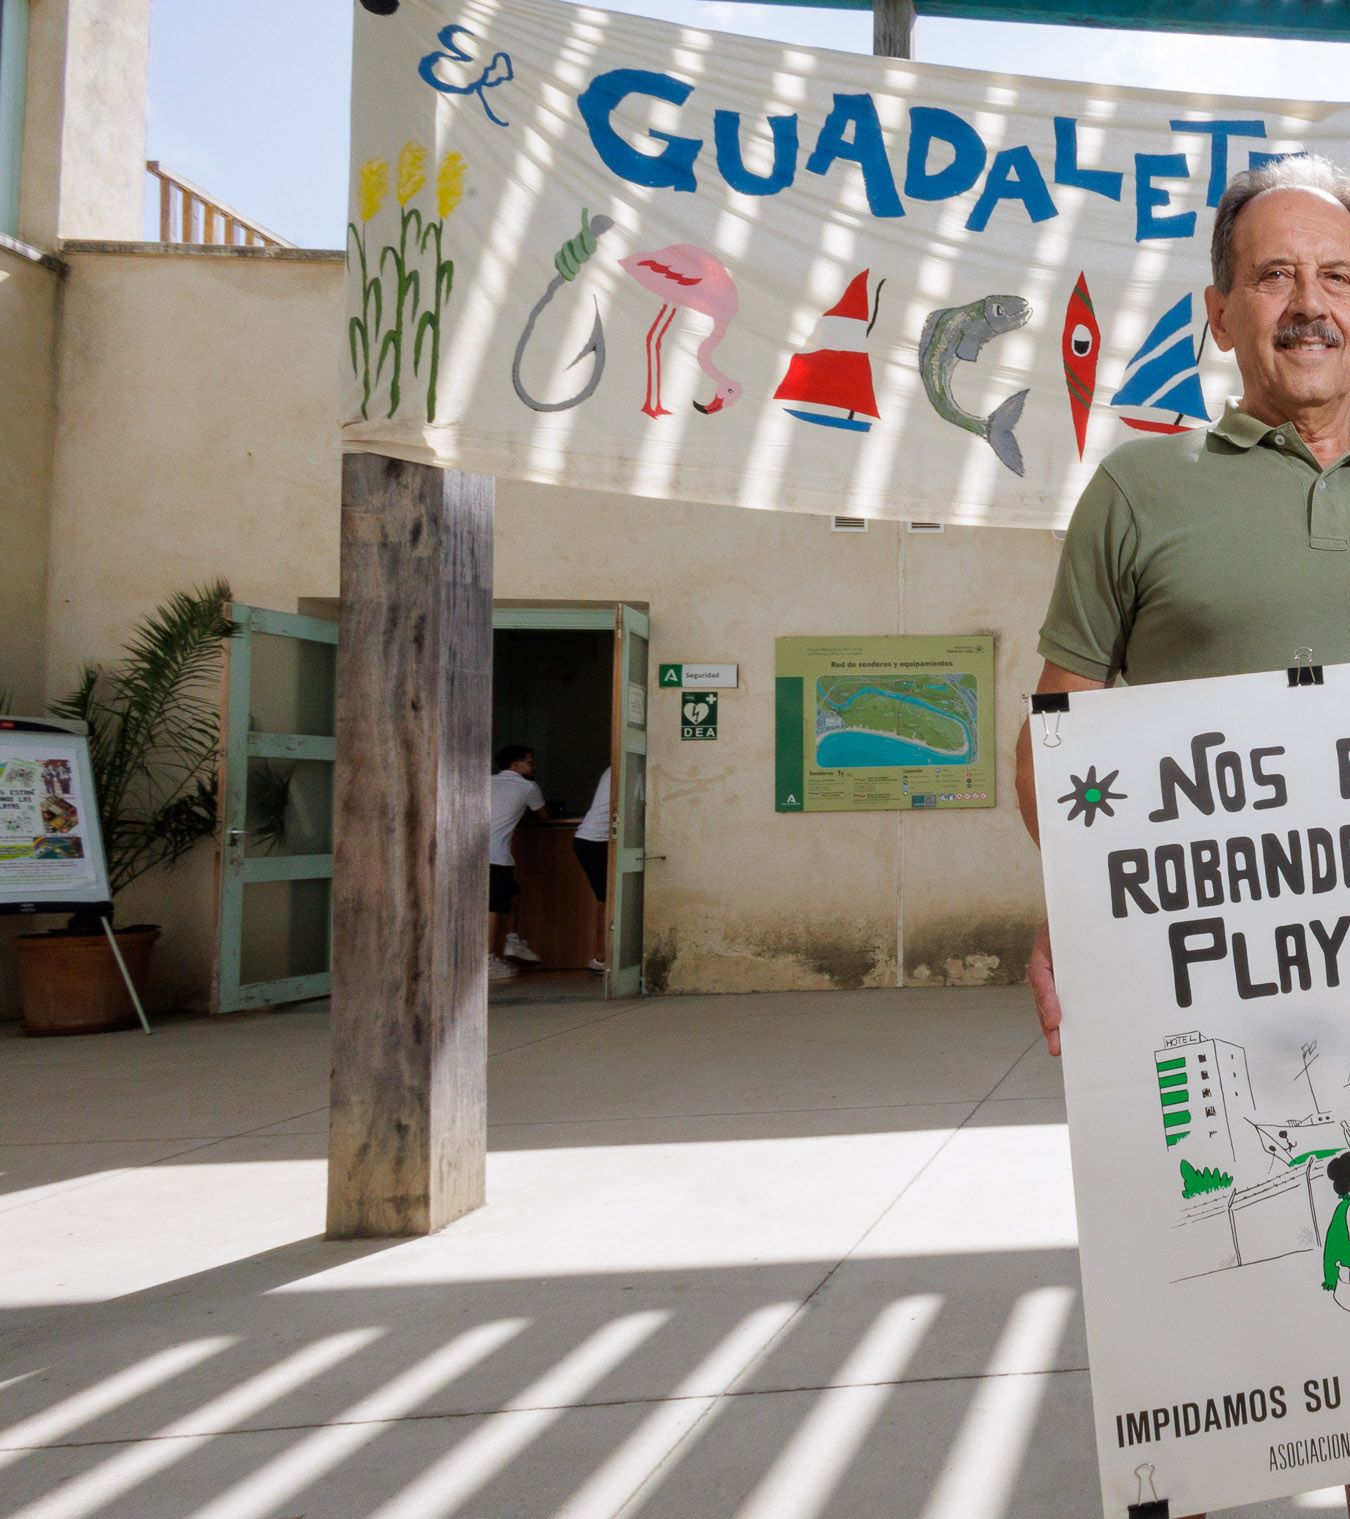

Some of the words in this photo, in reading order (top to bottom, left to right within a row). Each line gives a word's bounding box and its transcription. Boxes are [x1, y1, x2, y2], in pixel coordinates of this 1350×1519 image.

[577, 67, 1307, 242] GUADALET
[831, 660, 845, 669] Red
[847, 660, 857, 669] de
[858, 660, 892, 669] senderos
[899, 660, 953, 669] equipamientos
[685, 672, 720, 680] Seguridad
[683, 727, 716, 737] DEA
[1148, 732, 1288, 822] NOS
[1165, 1034, 1198, 1048] HOTEL
[1115, 1385, 1288, 1448] IMPIDAMOS
[1303, 1375, 1342, 1413] SU
